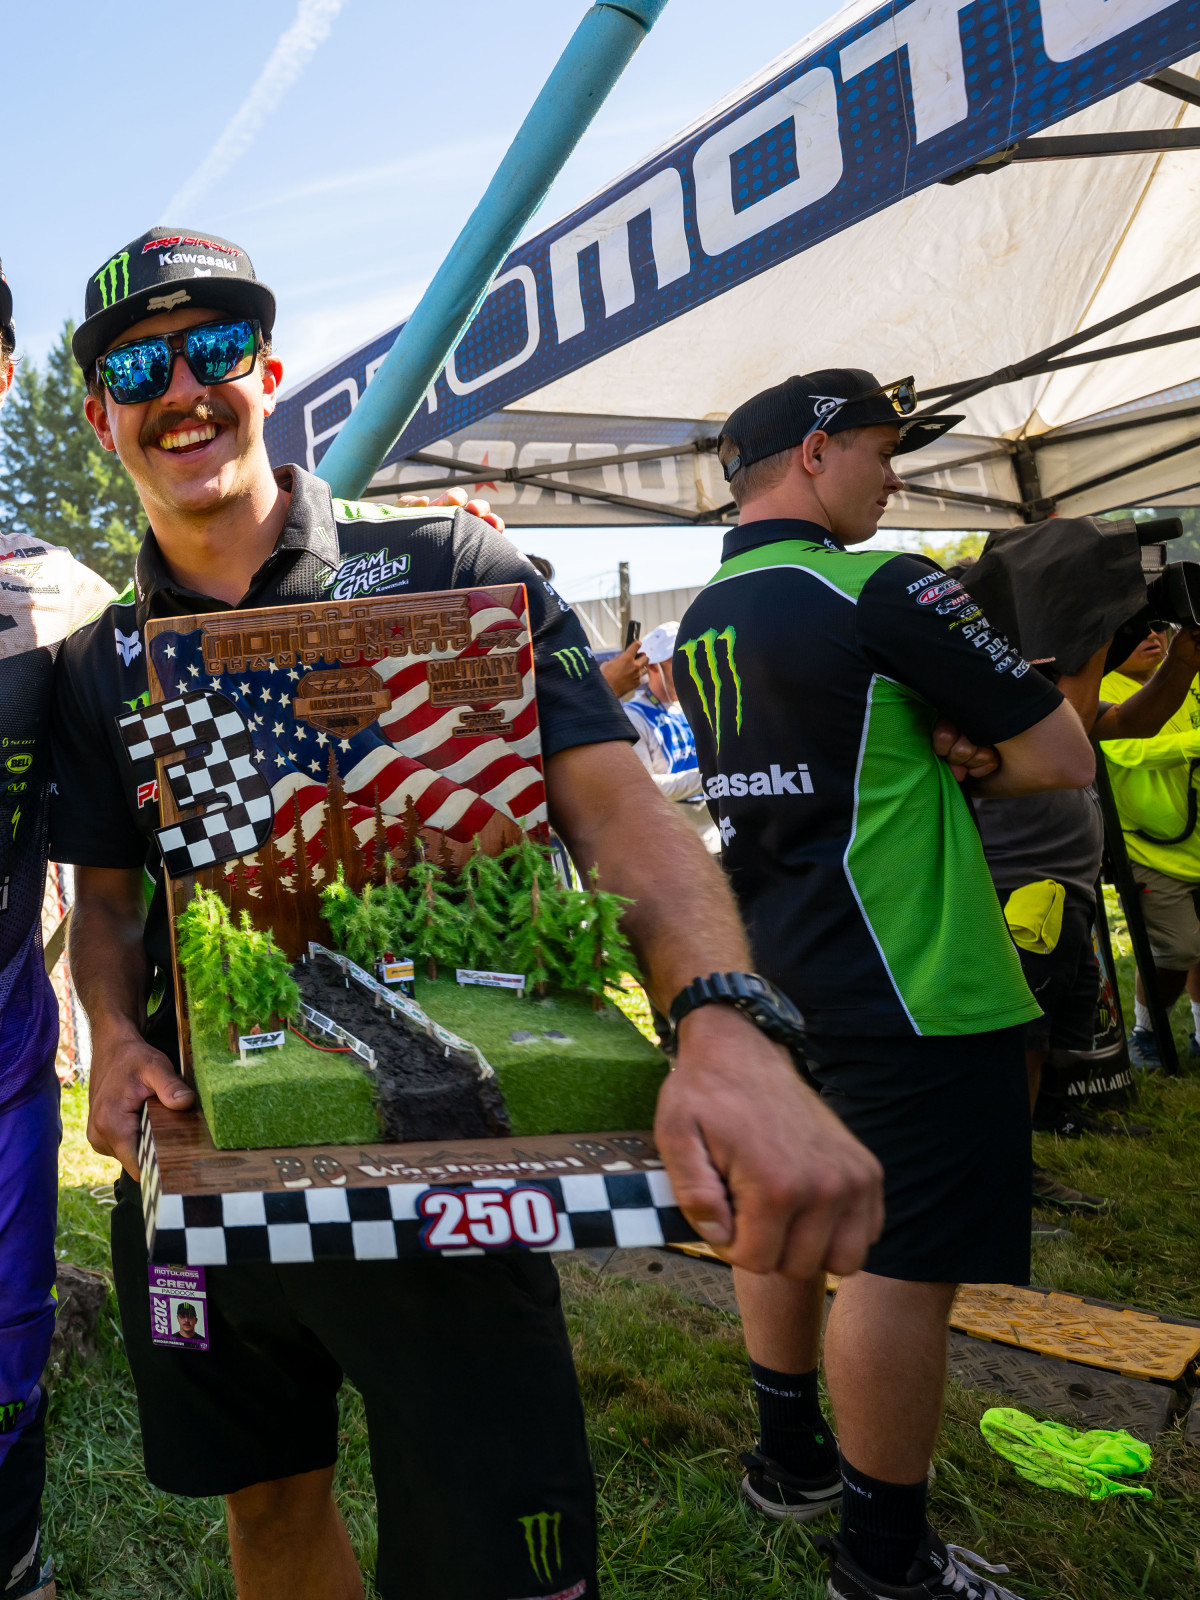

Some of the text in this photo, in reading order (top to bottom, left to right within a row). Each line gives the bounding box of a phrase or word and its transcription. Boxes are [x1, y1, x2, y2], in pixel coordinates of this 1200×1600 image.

[141, 235, 244, 258] PRO CIRCUIT
[303, 0, 1180, 473] PO MOT
[158, 251, 238, 272] Kawasaki
[332, 553, 410, 600] GREEN
[375, 578, 410, 593] Kawasaki
[299, 607, 370, 625] PRO
[202, 607, 471, 661] MOTOCROSS
[203, 636, 469, 675] CHAMPIONSHIP
[429, 654, 518, 681] MILITARY
[10, 757, 31, 769] BELL
[701, 763, 815, 800] asaki
[423, 1189, 557, 1247] 250
[154, 1268, 199, 1278] MOTOCROSS
[156, 1278, 197, 1290] CREW
[161, 1288, 195, 1297] PADDOCK
[153, 1296, 169, 1335] 2025
[753, 1377, 802, 1398] wasaki
